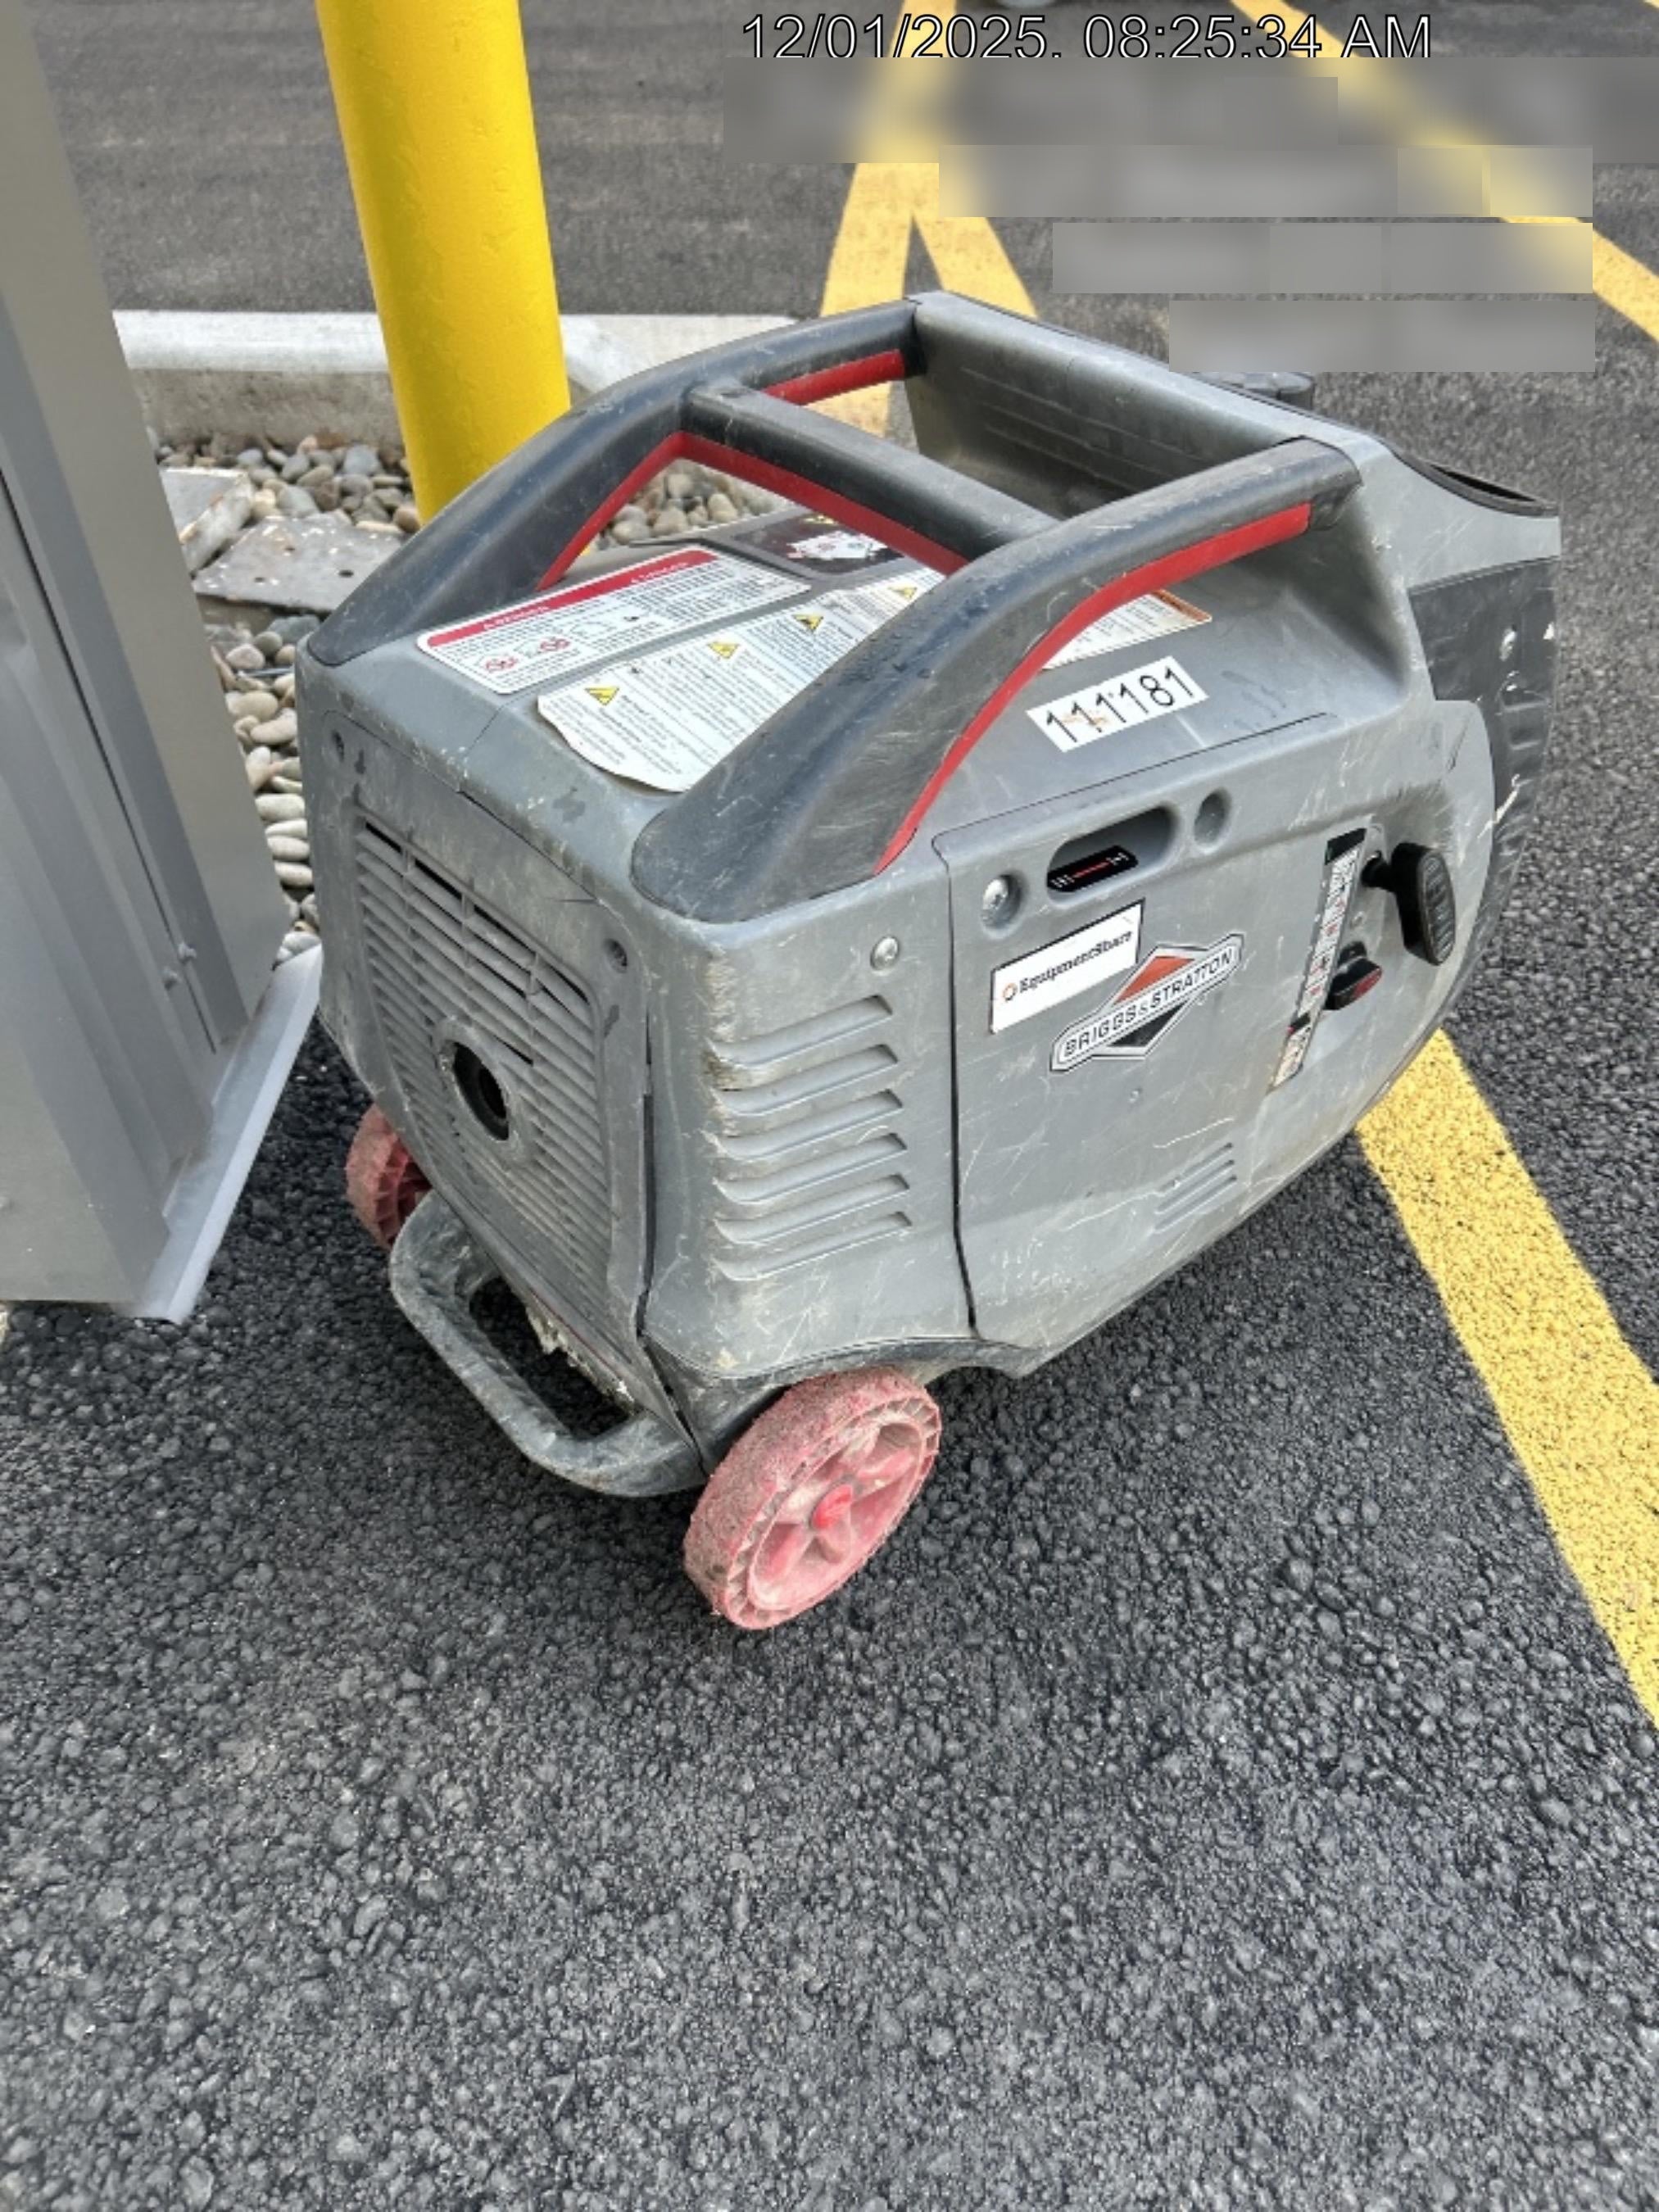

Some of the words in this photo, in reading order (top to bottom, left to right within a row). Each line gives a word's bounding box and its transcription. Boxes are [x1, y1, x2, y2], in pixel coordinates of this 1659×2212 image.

[1046, 666, 1194, 742] 111181
[1019, 931, 1133, 994] EquipmentShare
[1066, 1004, 1137, 1055] BRIGGS
[1150, 946, 1234, 1009] STRATTON
